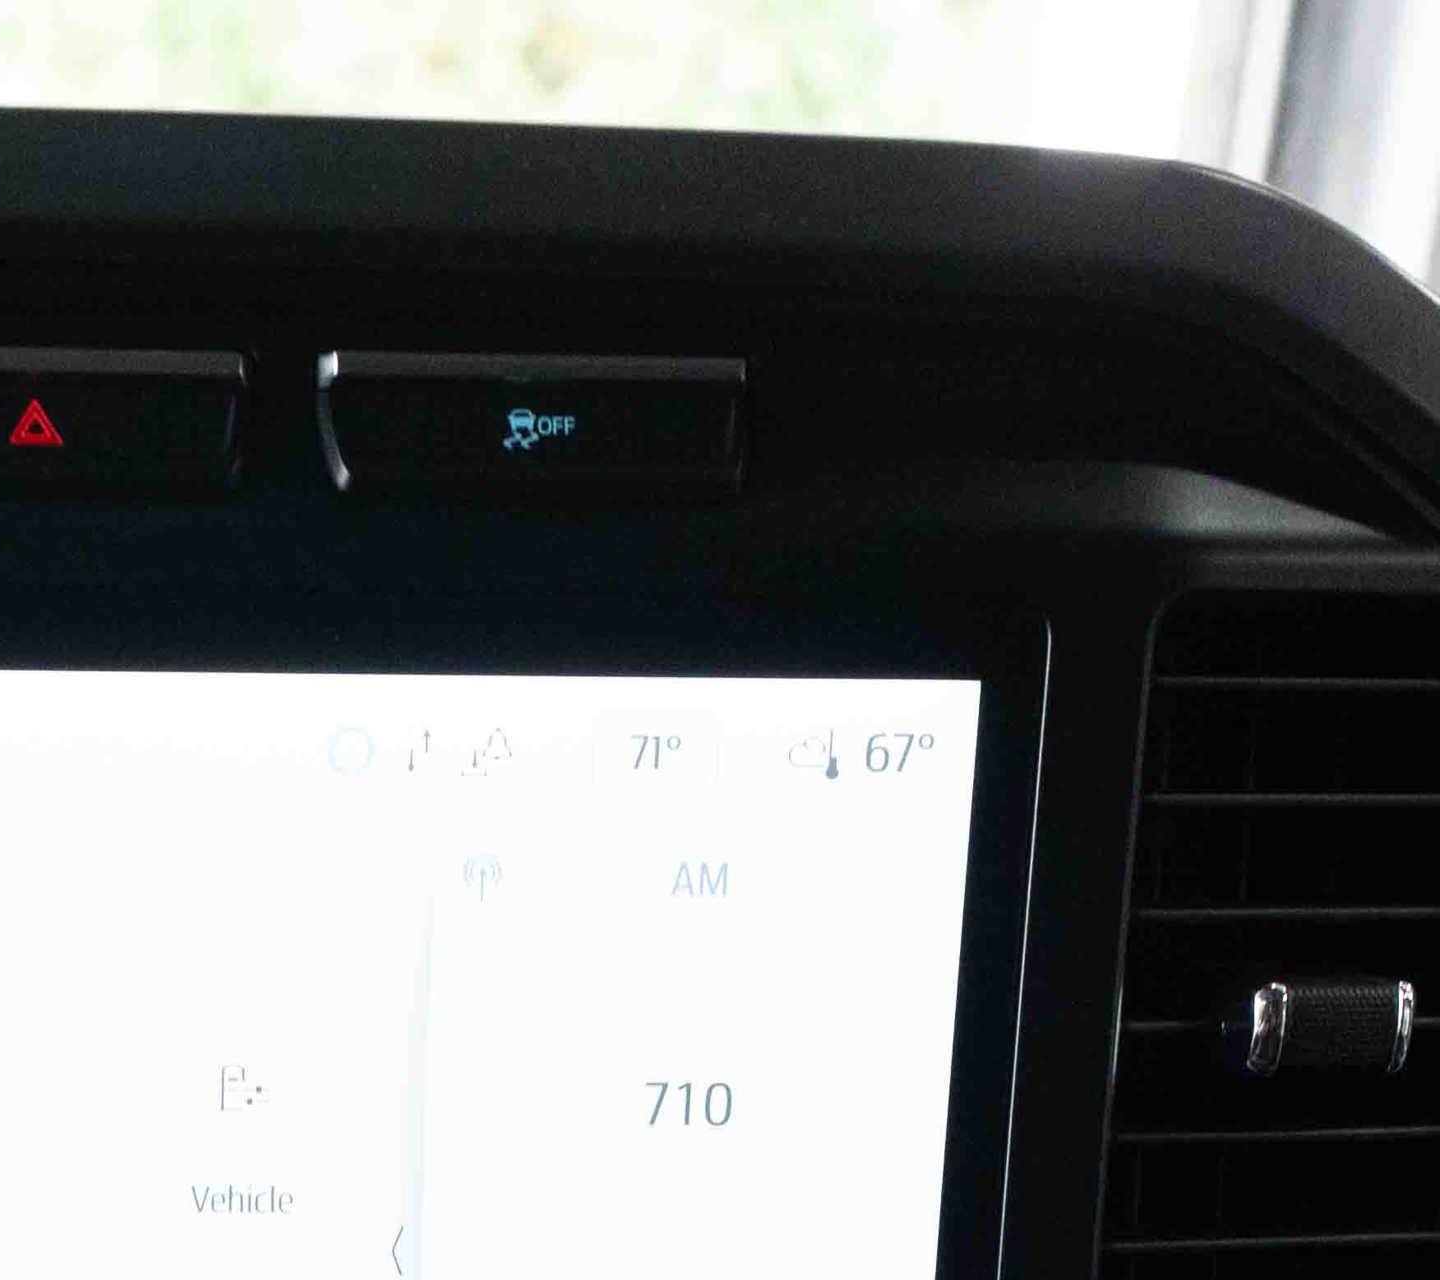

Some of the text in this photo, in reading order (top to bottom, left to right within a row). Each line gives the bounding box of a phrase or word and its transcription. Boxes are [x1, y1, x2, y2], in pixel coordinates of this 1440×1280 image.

[537, 415, 576, 436] OFF
[865, 732, 935, 774] 67°
[671, 861, 730, 898] AM
[645, 1080, 734, 1128] 710
[191, 1183, 294, 1214] Vehicle
